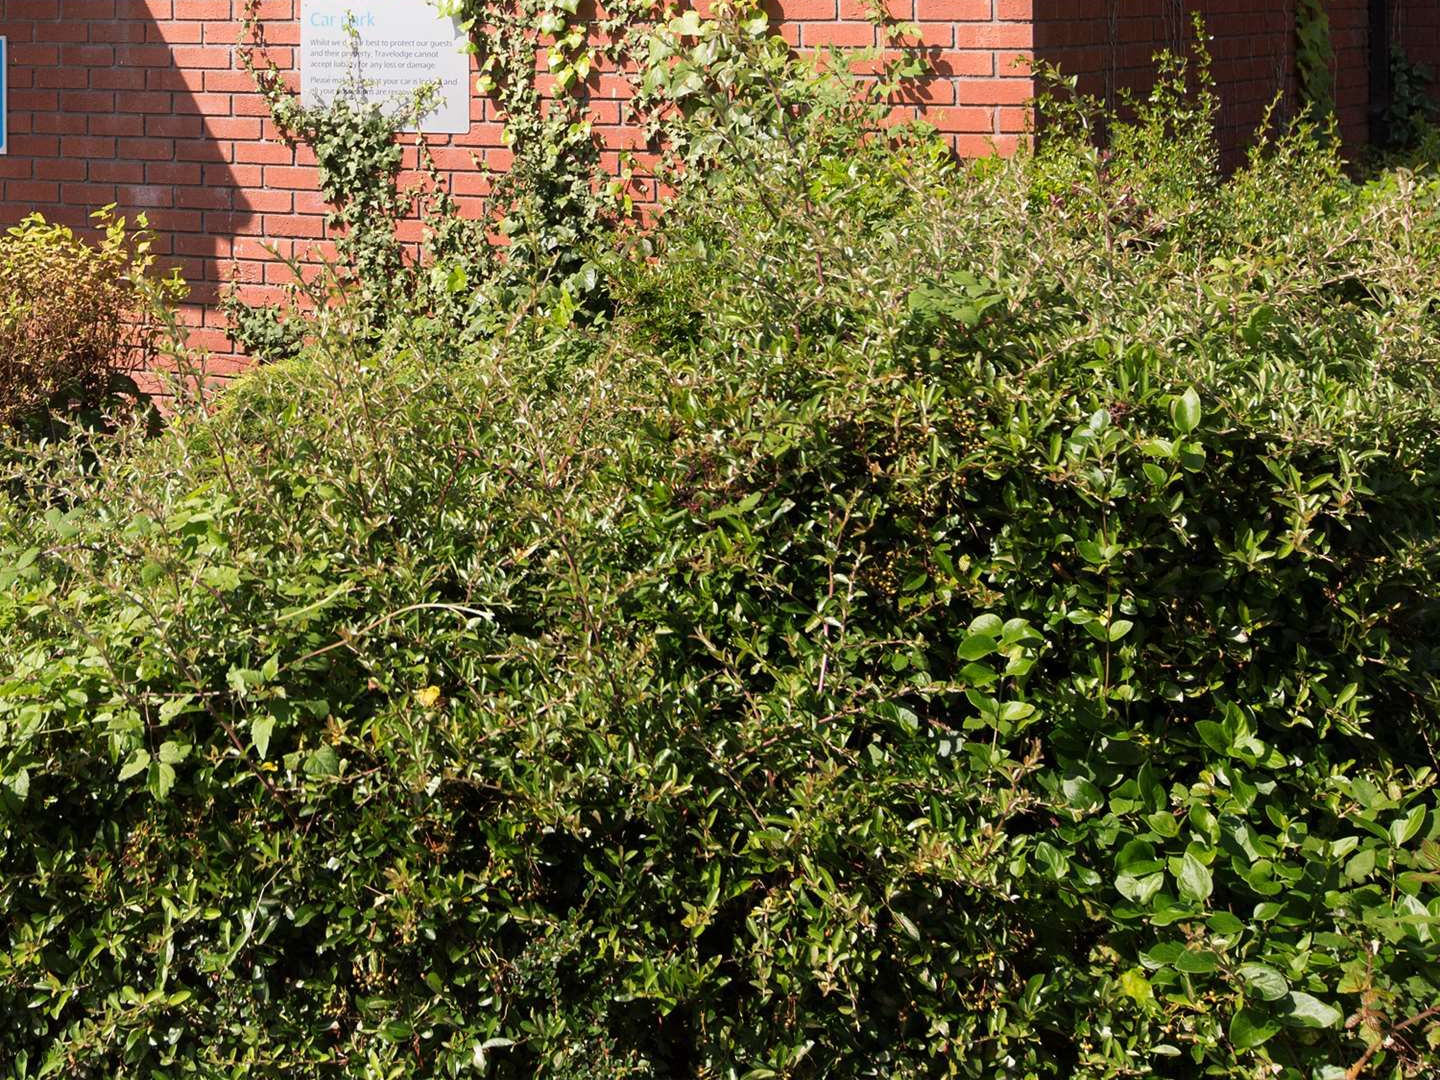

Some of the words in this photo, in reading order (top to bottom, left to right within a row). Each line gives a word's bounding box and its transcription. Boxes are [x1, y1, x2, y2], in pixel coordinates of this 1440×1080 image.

[310, 12, 336, 27] Car
[390, 40, 415, 48] protect
[430, 40, 453, 48] guests
[375, 50, 413, 59] Travelodge
[310, 60, 332, 69] accept
[370, 62, 382, 70] any
